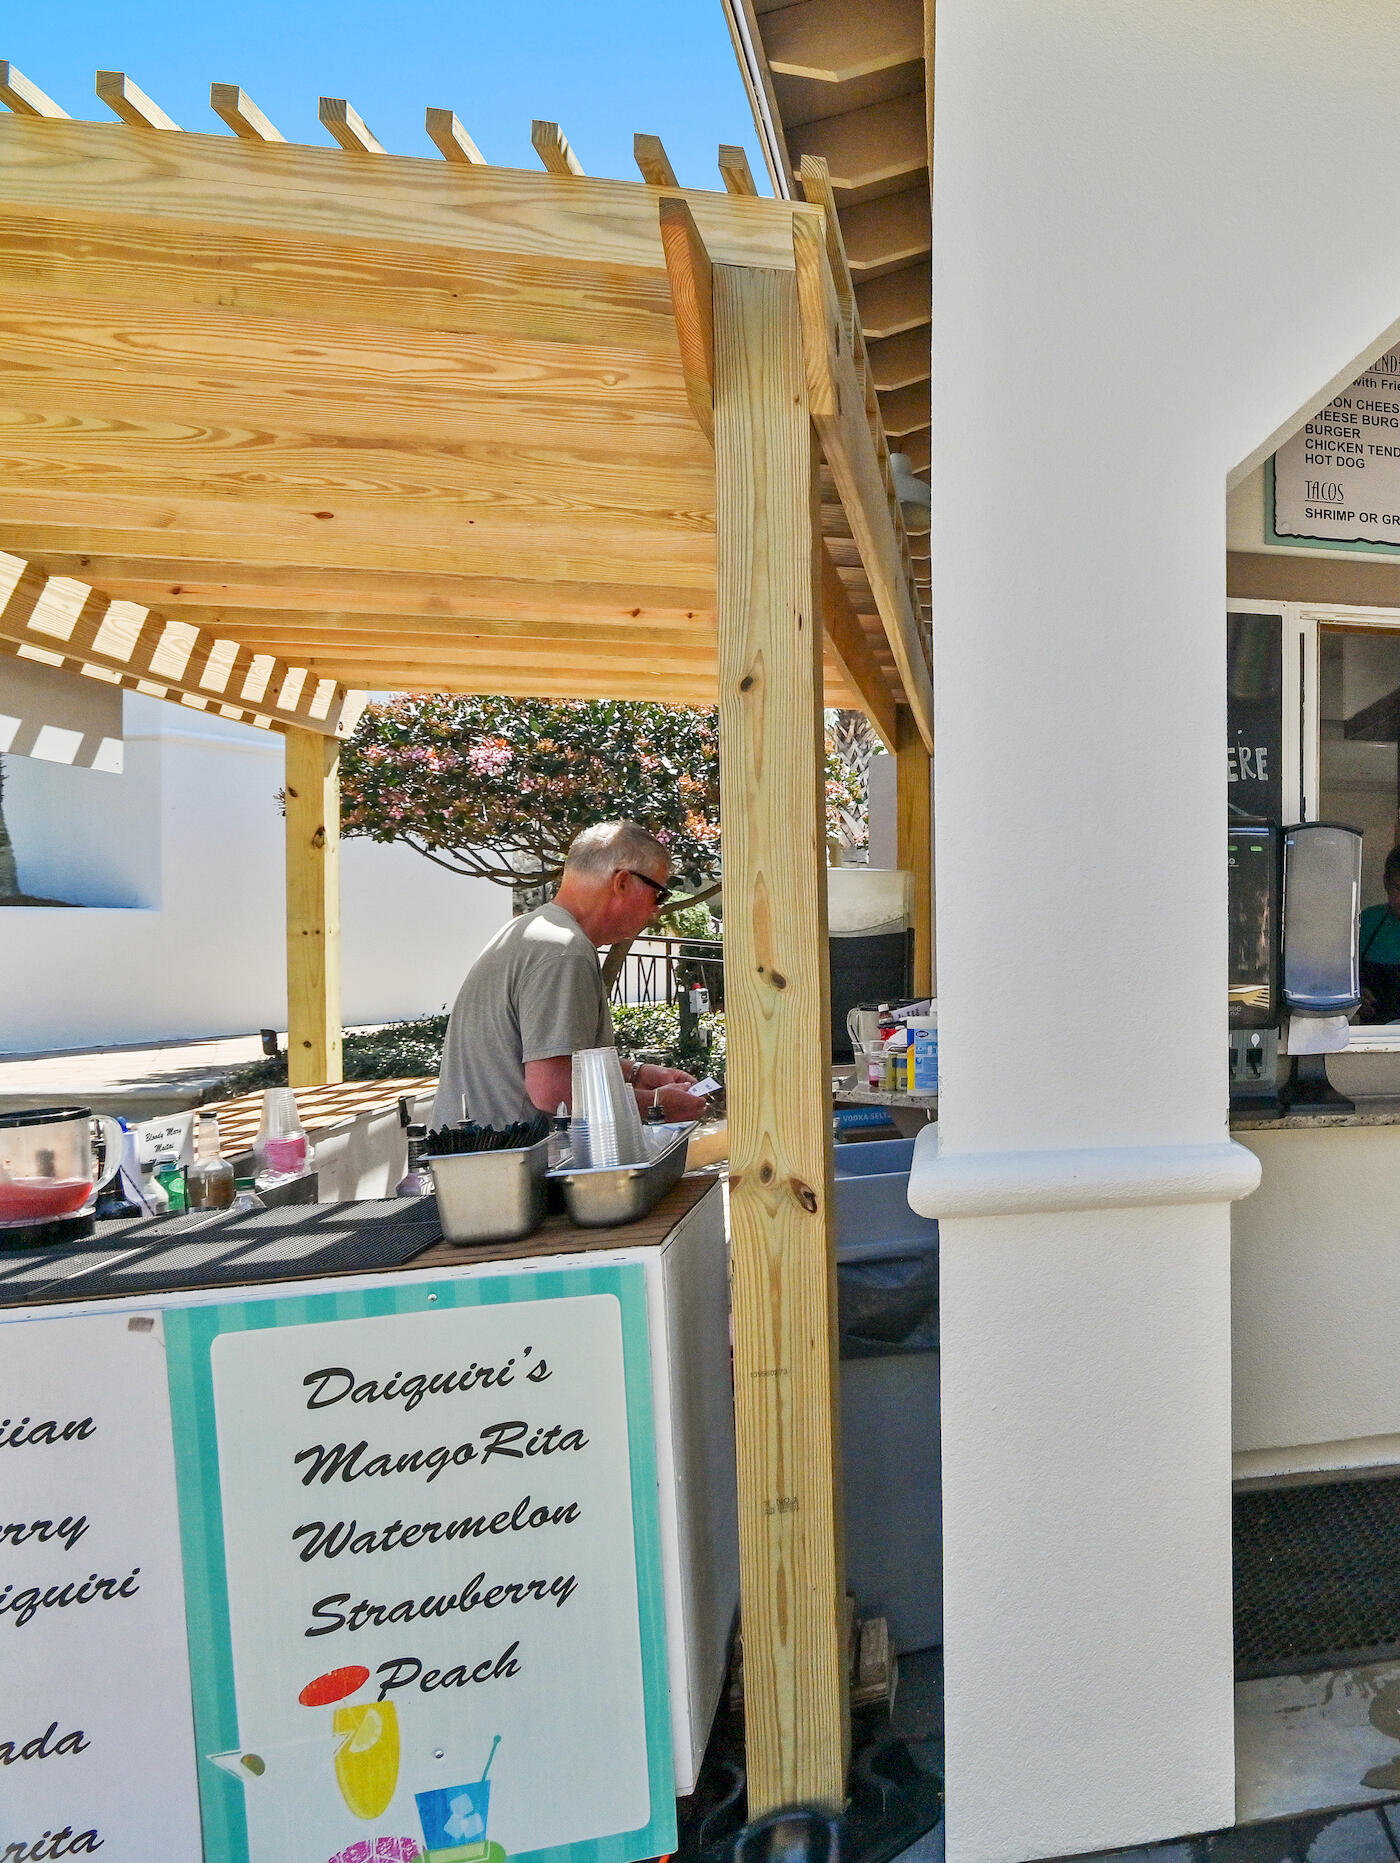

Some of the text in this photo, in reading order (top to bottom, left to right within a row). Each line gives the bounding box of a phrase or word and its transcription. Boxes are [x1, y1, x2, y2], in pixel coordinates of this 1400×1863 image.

[1353, 377, 1377, 389] with
[1314, 411, 1358, 424] HEESE
[1304, 423, 1361, 439] BURGER
[1304, 438, 1364, 455] CHICKEN
[1305, 453, 1333, 466] HOT
[1336, 455, 1366, 469] DOG
[1305, 480, 1344, 501] TACOS
[1304, 507, 1356, 522] SHRIMP
[1358, 512, 1379, 524] OR
[302, 1345, 553, 1413] Daiquiri's
[0, 1515, 90, 1551] rry
[291, 1495, 582, 1563] Watermelon
[303, 1571, 579, 1638] Strawberry
[375, 1640, 522, 1703] Peach
